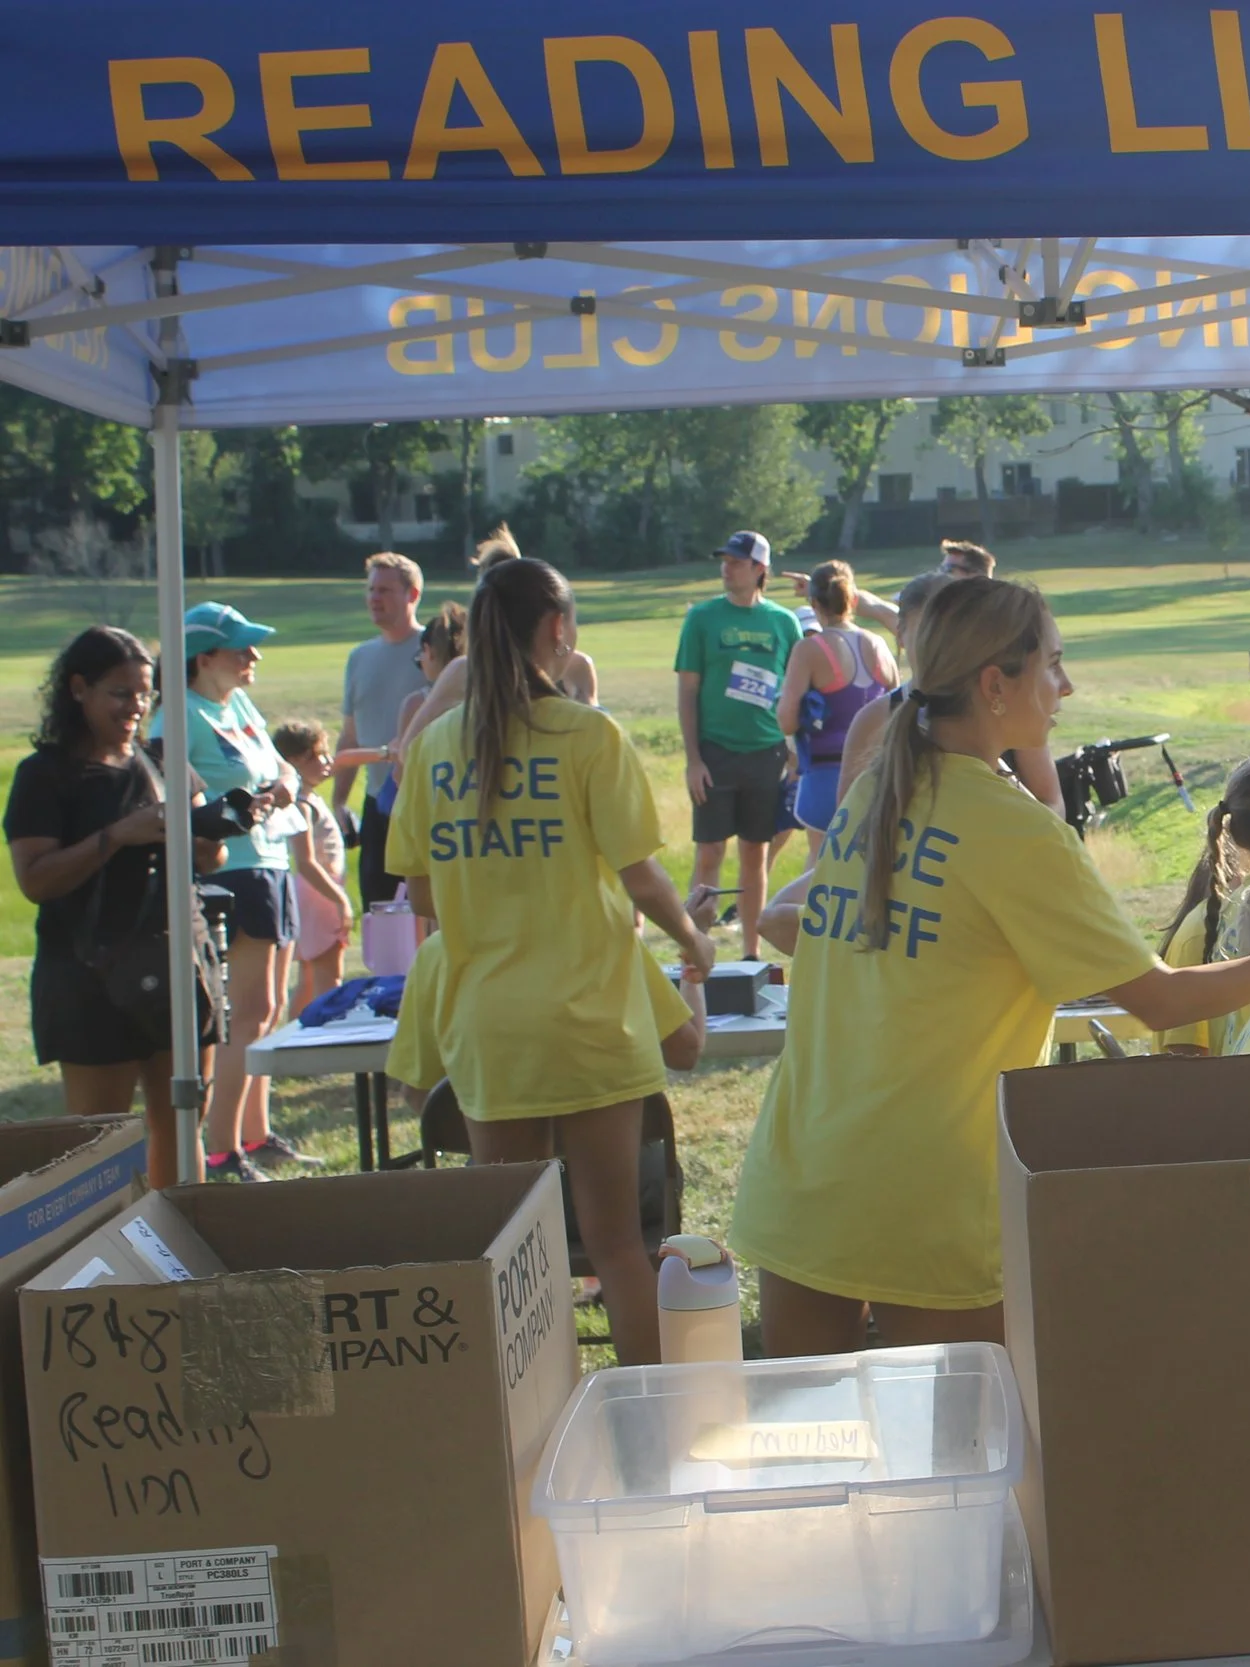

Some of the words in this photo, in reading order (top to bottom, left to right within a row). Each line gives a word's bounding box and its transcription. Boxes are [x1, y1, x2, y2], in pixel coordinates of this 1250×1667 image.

[107, 16, 1030, 181] READING
[430, 818, 564, 862] STAFF
[28, 1208, 46, 1231] FOR
[45, 1197, 67, 1221] EVERY
[68, 1175, 100, 1205] COMPANY
[103, 1164, 121, 1188] TEAM
[497, 1228, 538, 1335] PORT
[537, 1220, 550, 1278] &
[323, 1288, 400, 1334] RT
[413, 1286, 460, 1328] &
[506, 1283, 555, 1390] COMPANY
[60, 1382, 272, 1480] Readg
[158, 1572, 163, 1580] L
[180, 1559, 202, 1569] PORT
[205, 1559, 212, 1567] &
[213, 1556, 257, 1567] COMPANY
[207, 1569, 249, 1580] PC380LS
[85, 1646, 93, 1654] 72
